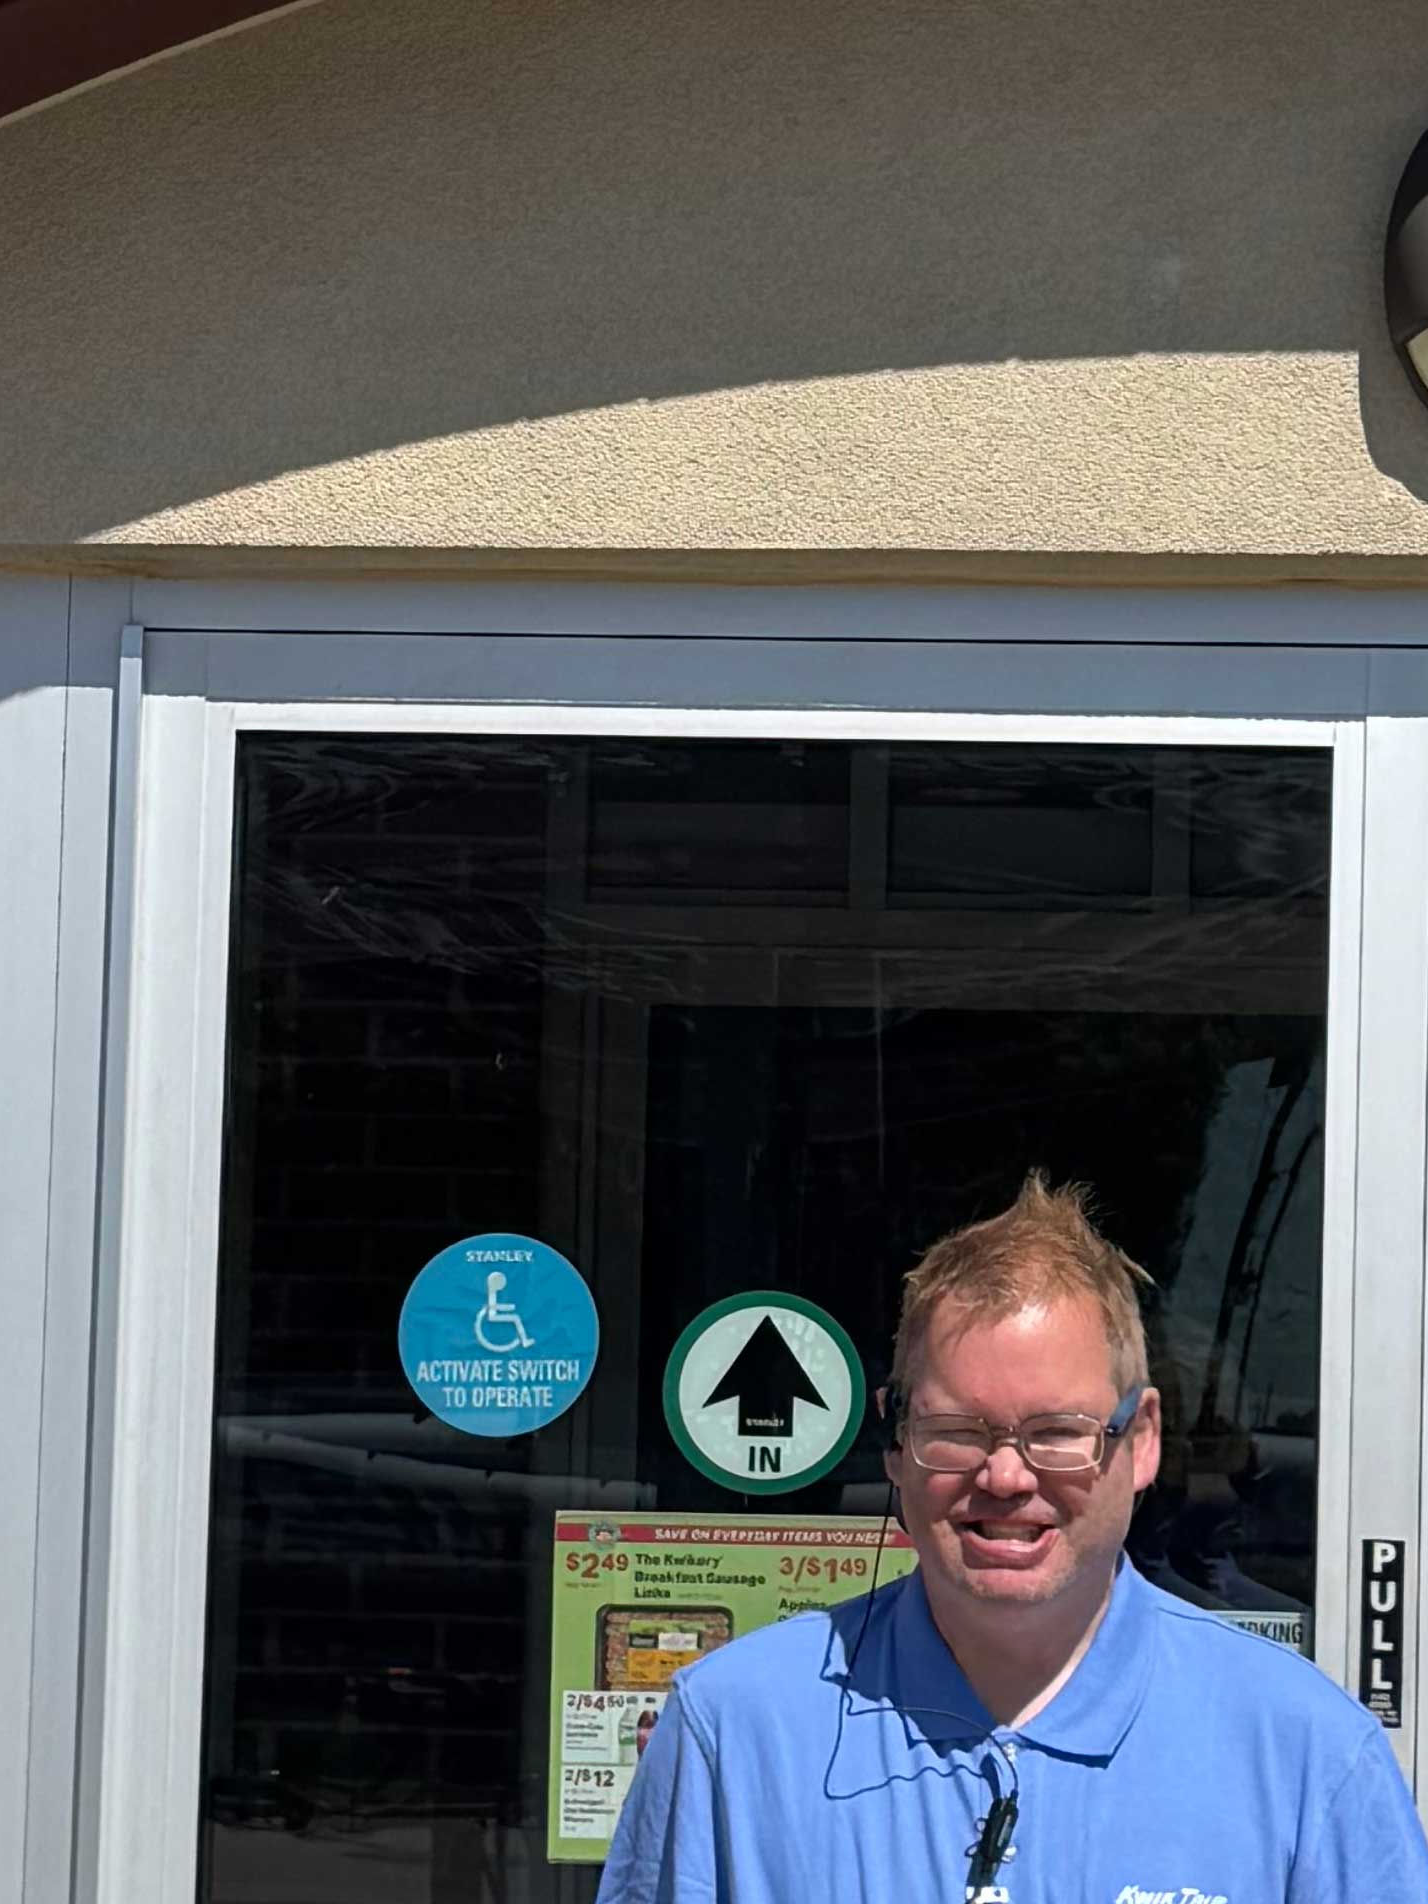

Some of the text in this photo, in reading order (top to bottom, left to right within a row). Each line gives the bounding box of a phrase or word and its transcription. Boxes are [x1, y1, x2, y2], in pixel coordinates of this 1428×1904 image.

[465, 1250, 534, 1262] STANLEY
[416, 1359, 580, 1382] ACTIVATE SWITCH
[443, 1386, 553, 1408] TO OPERATE
[748, 1445, 782, 1473] IN
[654, 1528, 688, 1540] SAVE
[691, 1529, 710, 1541] ON
[782, 1530, 823, 1543] ITEMS
[826, 1531, 853, 1544] YOU
[635, 1553, 661, 1566] The
[634, 1571, 704, 1584] Breakfast
[1370, 1542, 1397, 1690] PULL
